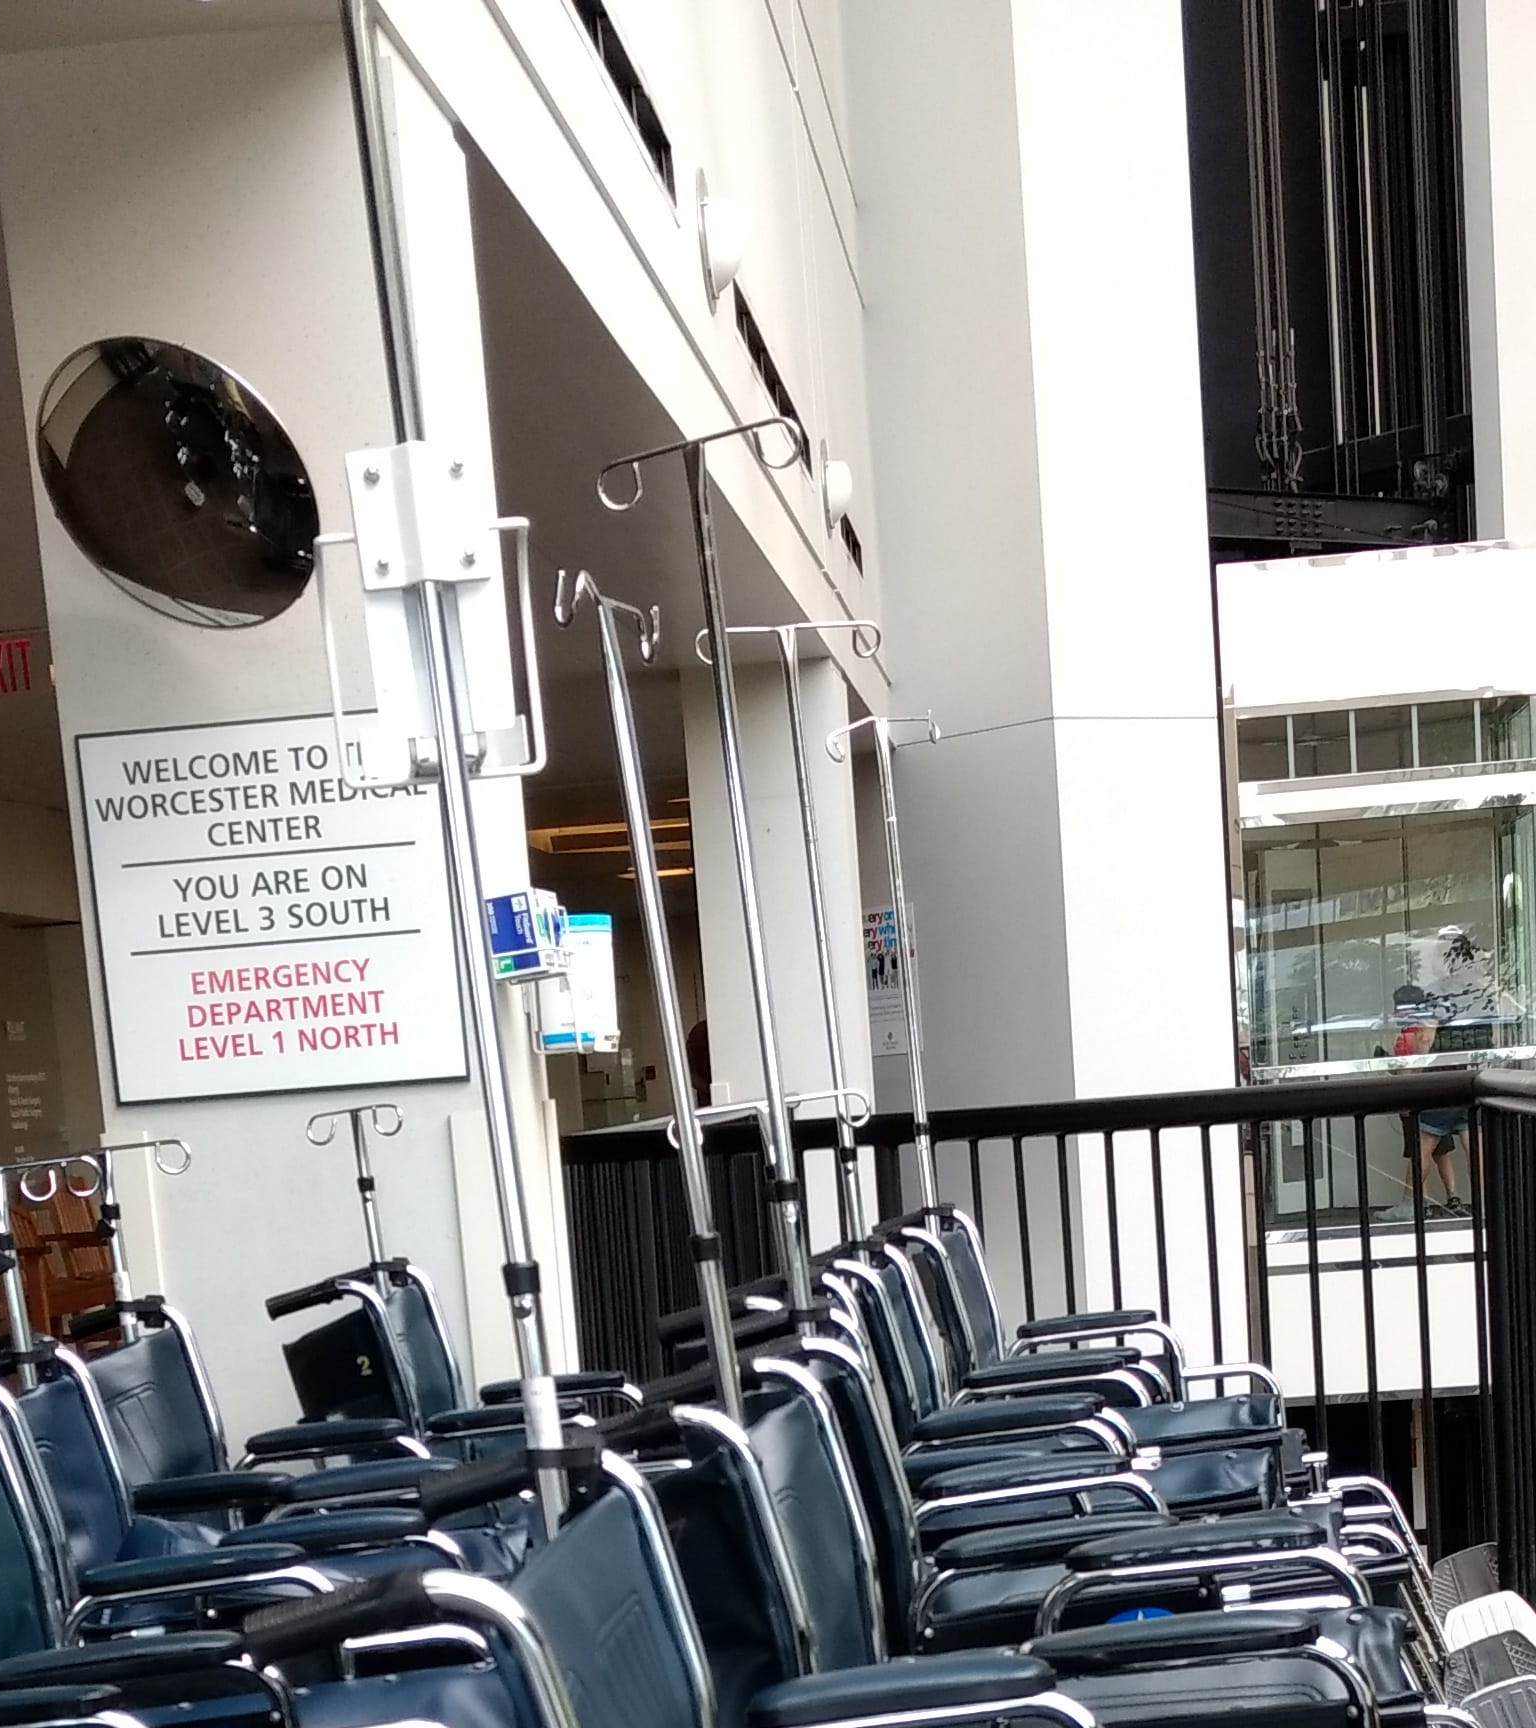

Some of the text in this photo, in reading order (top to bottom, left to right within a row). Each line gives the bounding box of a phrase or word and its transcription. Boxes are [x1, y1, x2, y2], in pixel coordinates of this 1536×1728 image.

[122, 749, 279, 786] WELCOME
[288, 745, 328, 771] TO
[95, 783, 280, 822] WORCESTER
[207, 815, 323, 847] CENTER
[173, 863, 368, 902] YOU ARE ON
[158, 897, 391, 938] LEVEL 3 SOUTH
[191, 958, 370, 995] EMERGENCY
[187, 990, 385, 1028] DEPARTMENT
[179, 1022, 400, 1061] LEVEL 1 NORTH
[356, 1355, 373, 1376] 2
